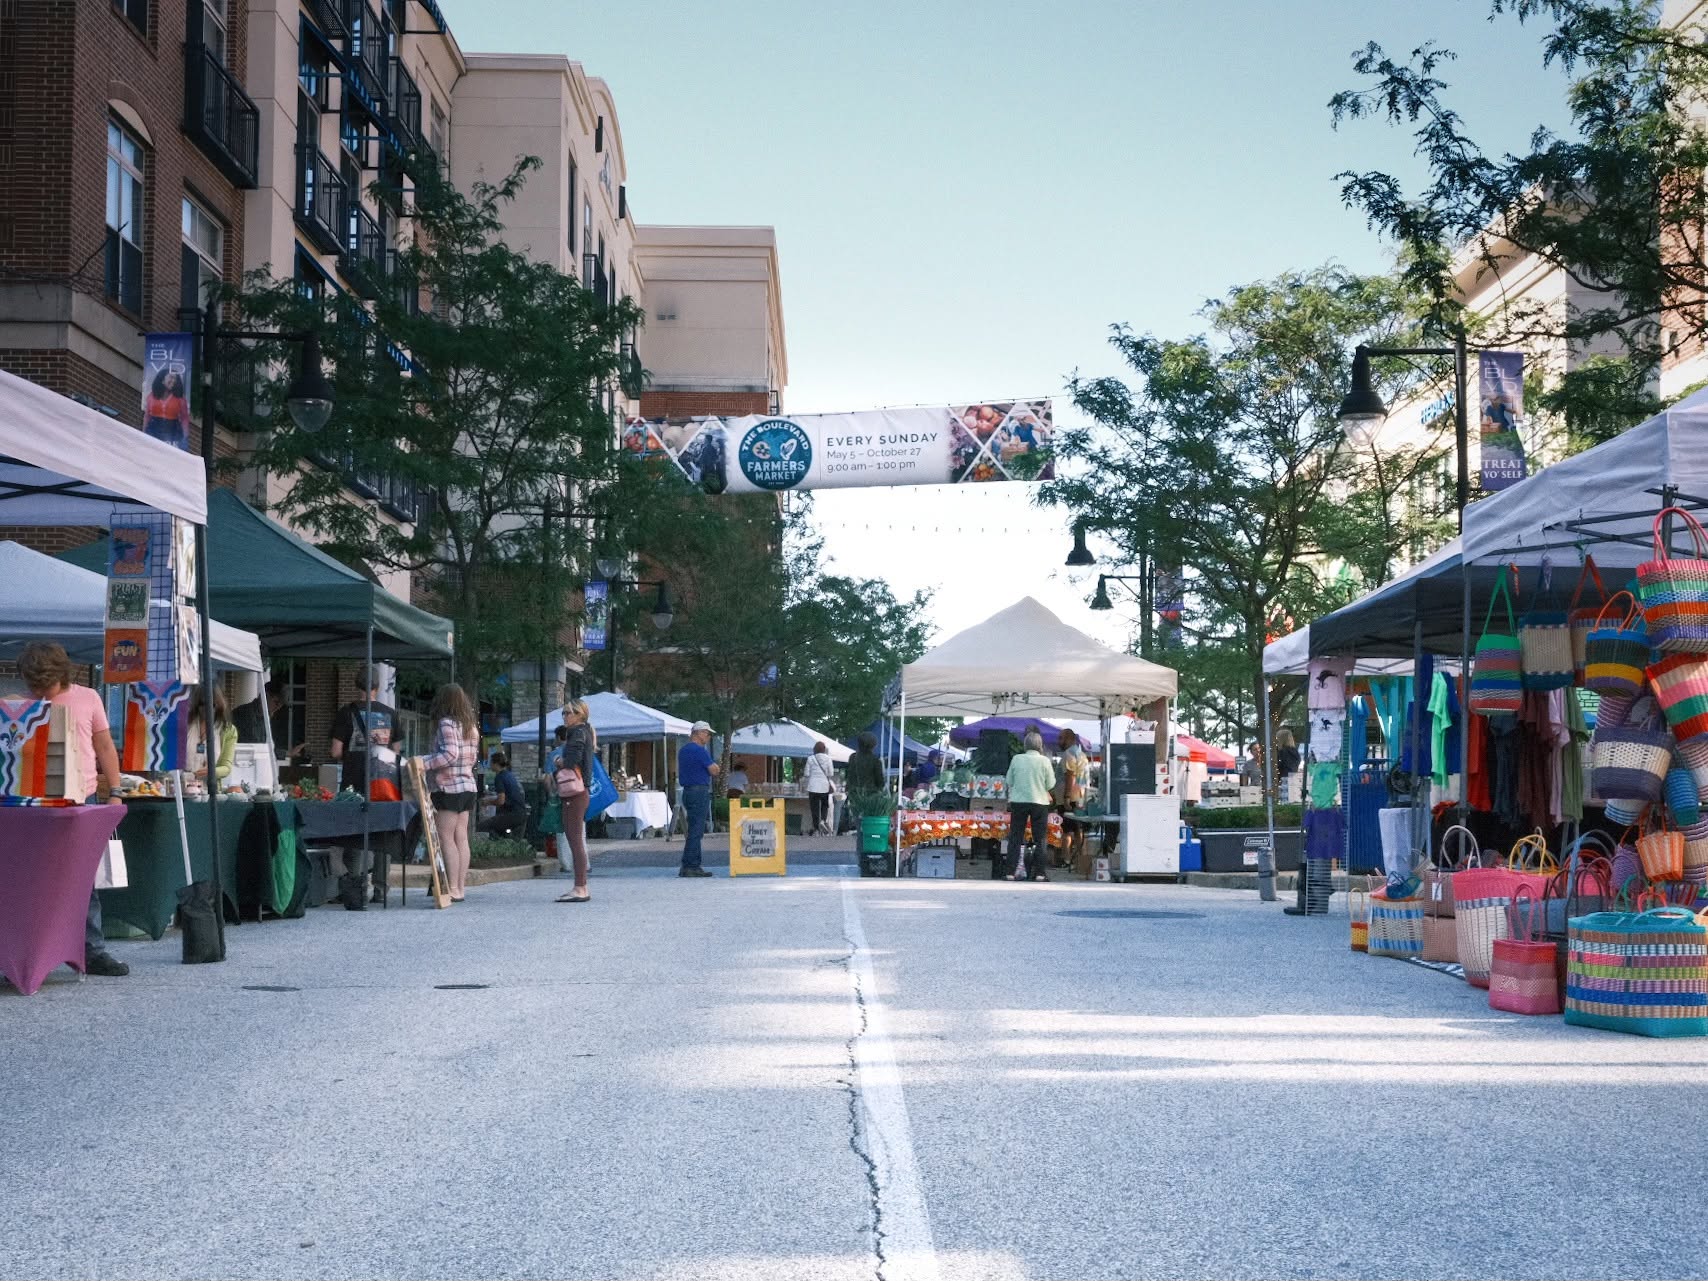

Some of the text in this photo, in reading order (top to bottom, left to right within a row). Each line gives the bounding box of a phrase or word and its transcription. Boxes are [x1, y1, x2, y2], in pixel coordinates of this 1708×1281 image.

[150, 349, 185, 361] BL
[742, 421, 809, 452] THE BOULEVARD
[827, 432, 938, 447] EVERY SUNDAY
[827, 450, 848, 461] May
[850, 450, 856, 460] 5
[867, 447, 908, 458] October
[910, 447, 921, 457] 27
[747, 460, 806, 473] FARMERS
[827, 463, 849, 474] 9:00
[850, 463, 867, 472] am
[876, 461, 897, 470] 1:00
[899, 460, 916, 472] pm
[1484, 459, 1523, 469] TREAT
[755, 471, 797, 481] MARKET
[114, 645, 138, 657] FUN
